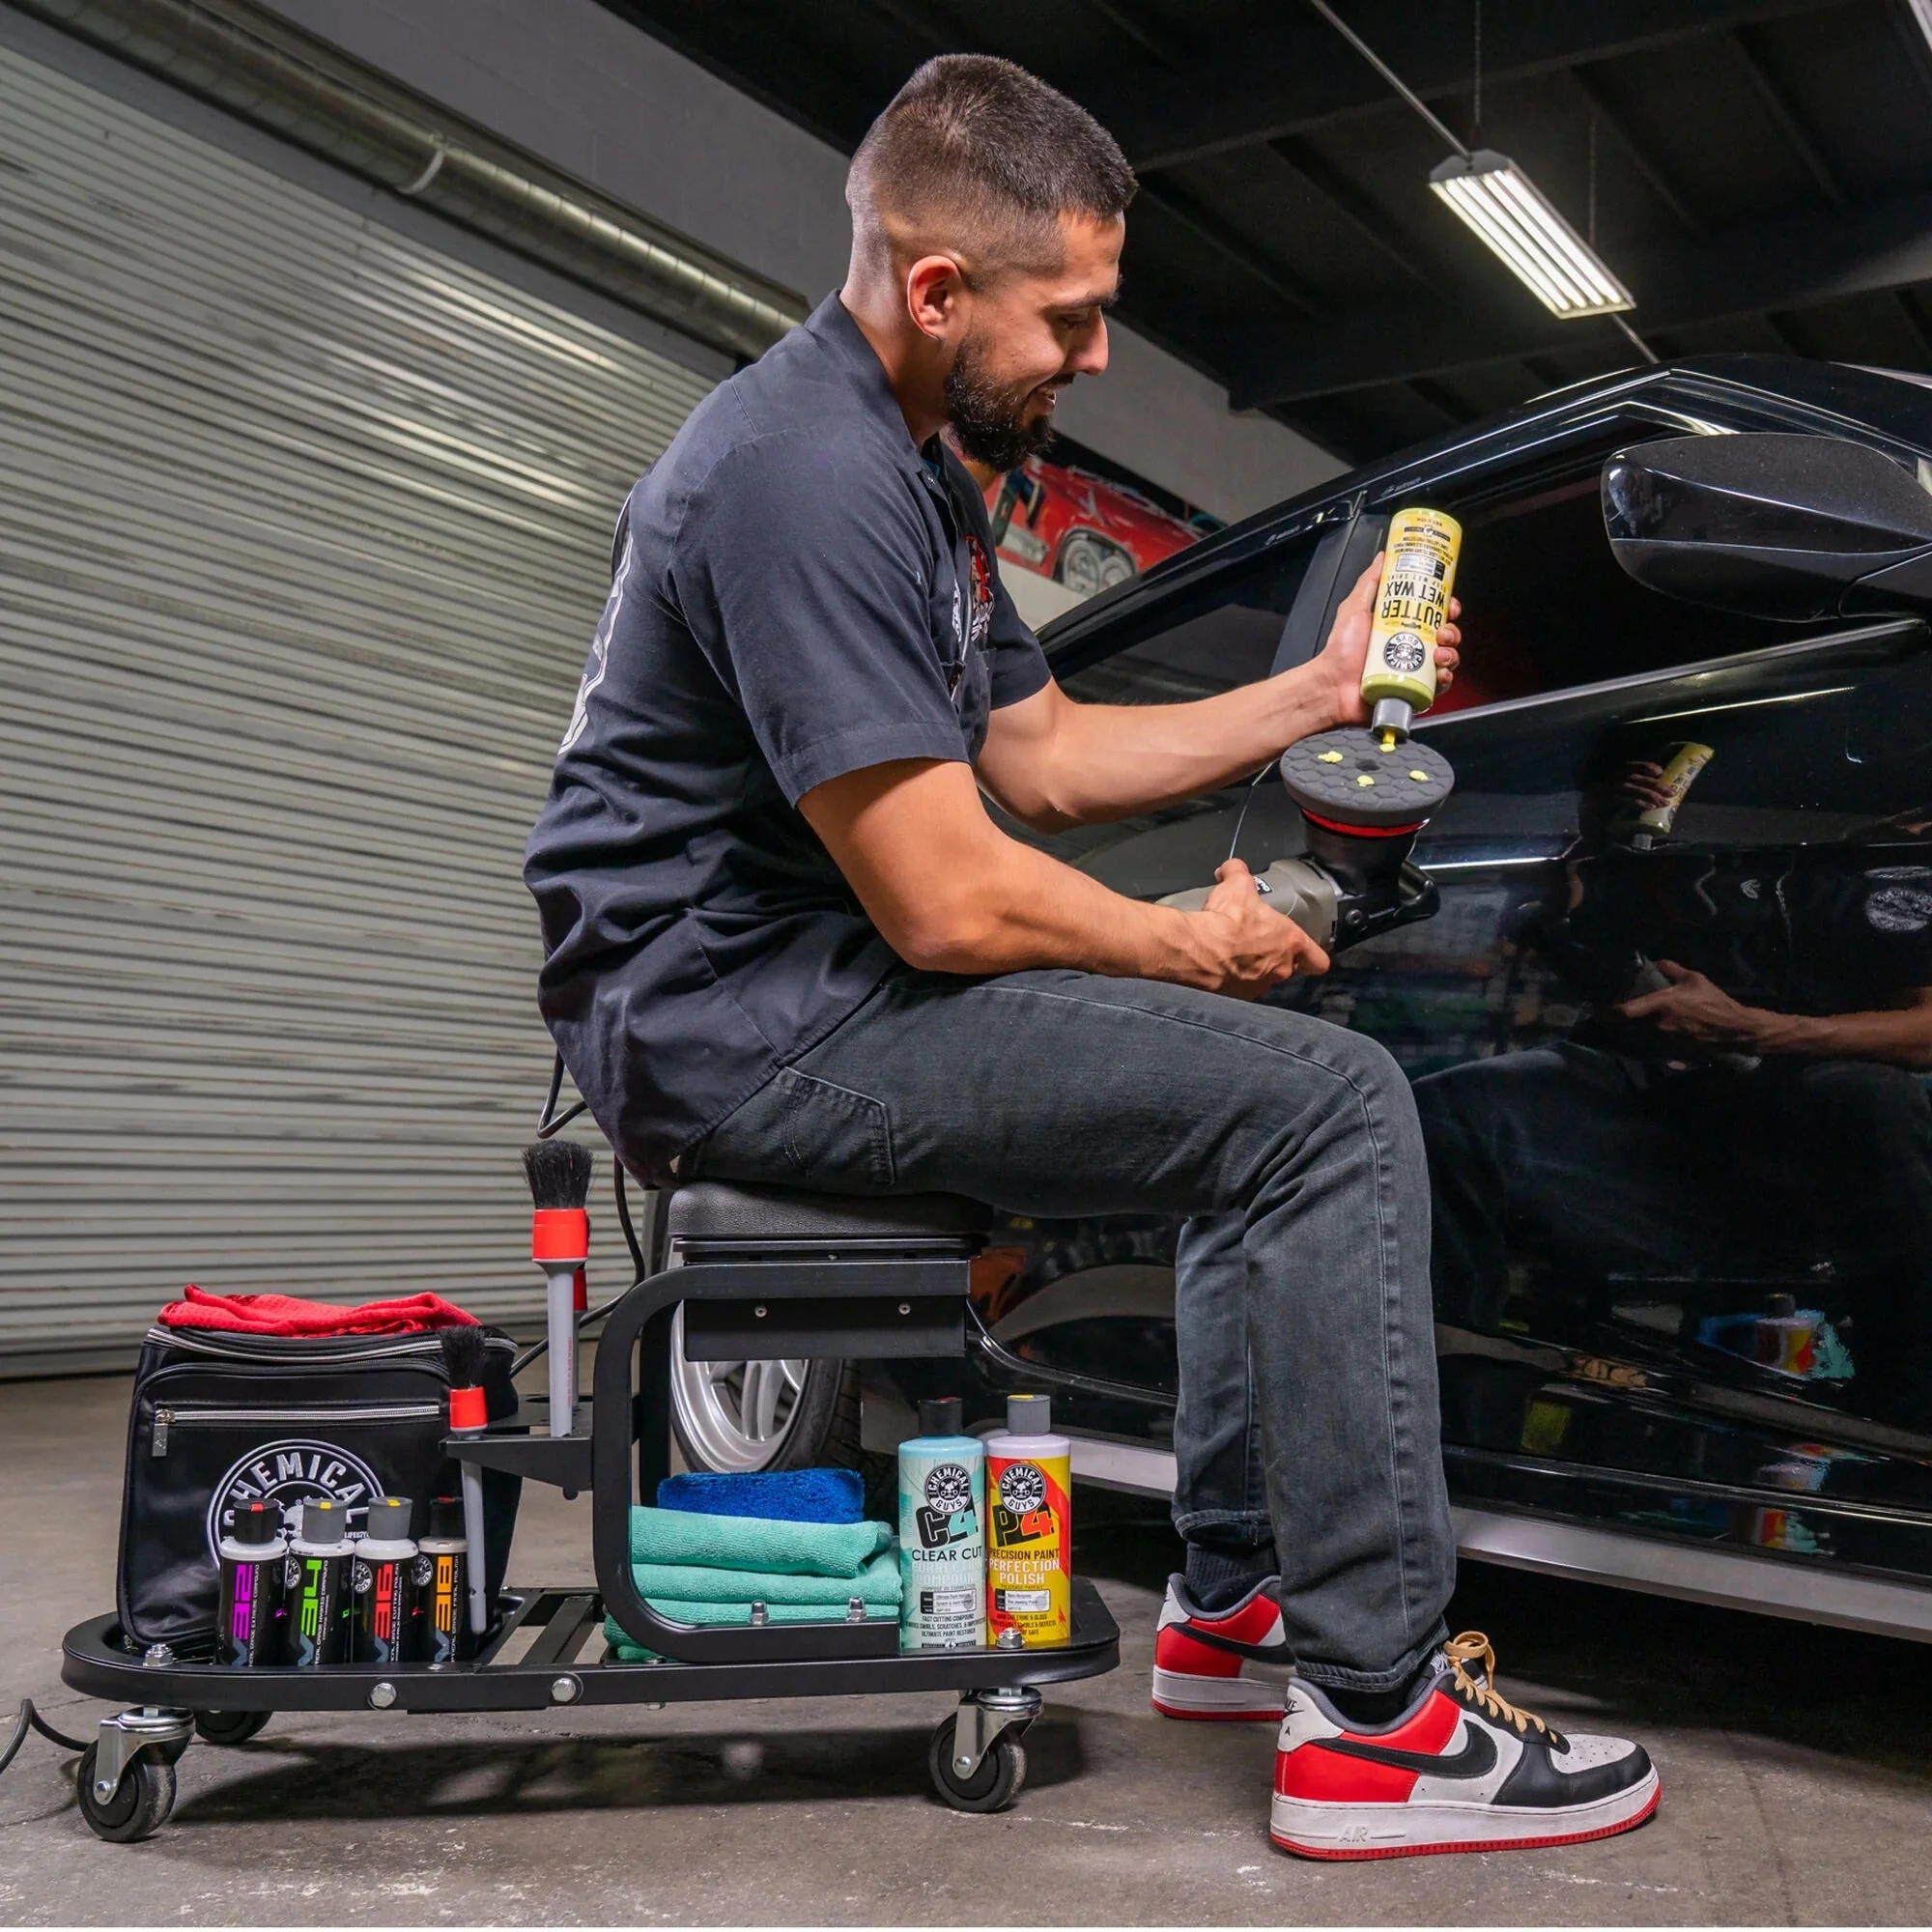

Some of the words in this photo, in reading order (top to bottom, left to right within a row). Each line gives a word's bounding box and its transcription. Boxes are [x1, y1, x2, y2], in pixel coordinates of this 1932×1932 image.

[1385, 581, 1414, 598] WAX
[1418, 584, 1446, 610] WET
[1381, 599, 1443, 630] BUTTER
[1395, 635, 1420, 646] GUYS
[1385, 648, 1422, 670] CHEMICAL
[927, 1464, 969, 1492] CHEMICAL
[1002, 1464, 1042, 1491] CHEMICAL
[935, 1498, 963, 1511] GUYS
[1008, 1499, 1035, 1511] GUYS
[916, 1498, 979, 1548] C4
[992, 1501, 1055, 1548] P4
[911, 1548, 957, 1562] CLEAR
[961, 1546, 982, 1560] CUT
[989, 1548, 1031, 1560] PRECISION
[1034, 1548, 1060, 1560] PAINT
[989, 1558, 1060, 1573] PERFECTION
[999, 1572, 1045, 1585] POLISH
[1339, 1825, 1368, 1842] AIR
